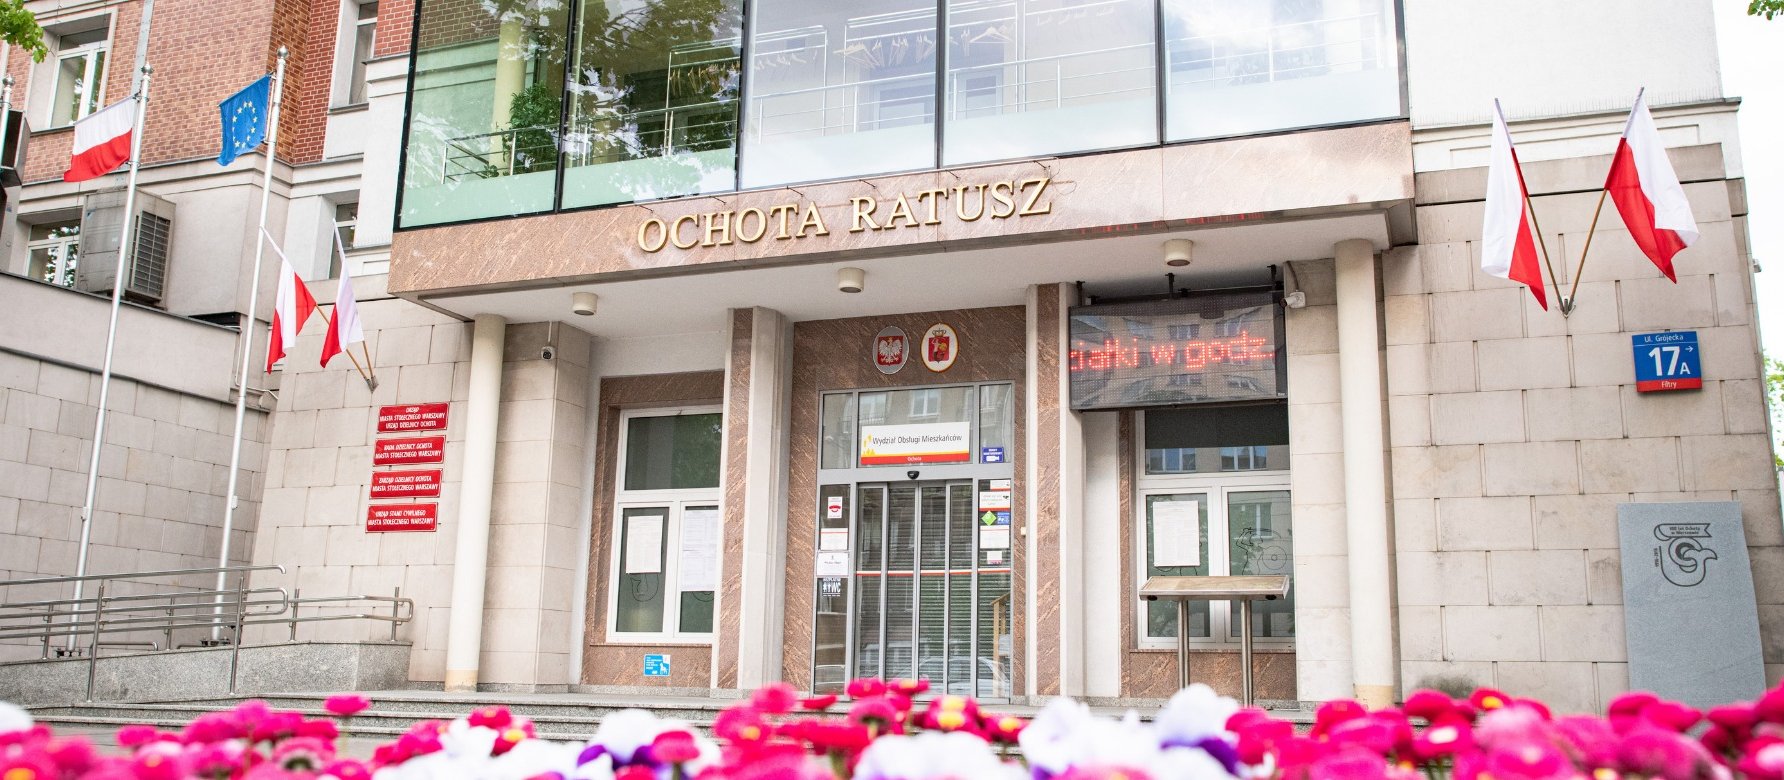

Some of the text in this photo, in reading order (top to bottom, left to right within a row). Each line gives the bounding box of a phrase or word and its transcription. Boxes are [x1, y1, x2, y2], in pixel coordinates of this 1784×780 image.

[637, 177, 1052, 252] OCHOTA RATUSZ
[1655, 333, 1684, 343] Grójecka
[1151, 343, 1175, 365] w
[1186, 329, 1274, 370] godz.
[1661, 380, 1677, 389] Filtry
[872, 434, 963, 447] Wydział Obsługi Mieszkańców
